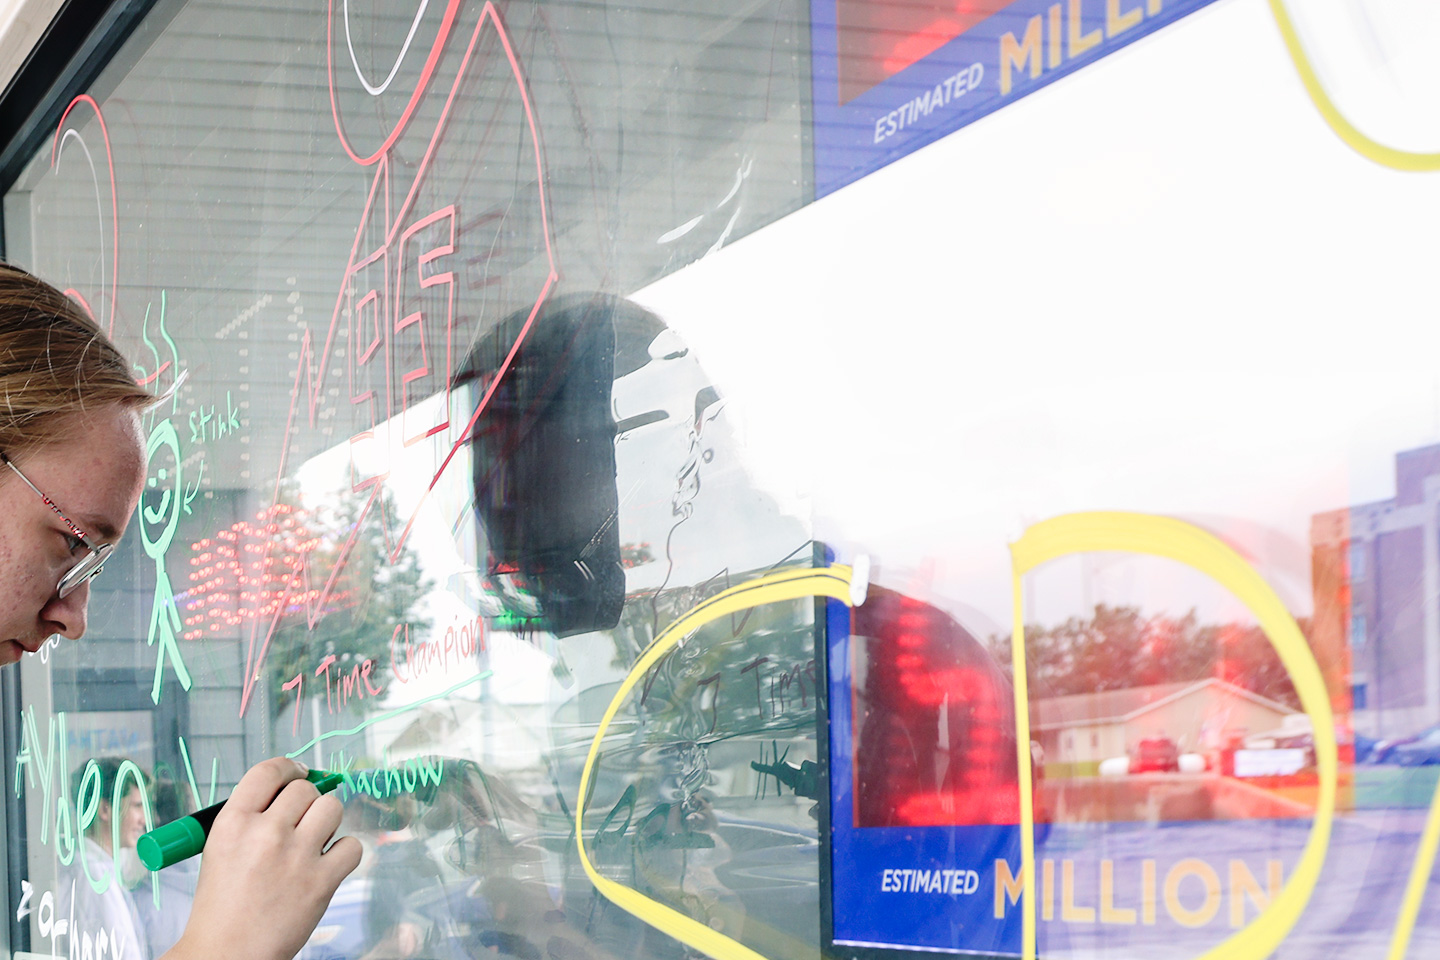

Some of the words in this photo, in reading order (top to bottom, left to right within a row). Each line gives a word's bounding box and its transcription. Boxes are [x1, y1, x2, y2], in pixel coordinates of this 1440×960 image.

[873, 61, 984, 144] ESTIMATED
[999, 0, 1162, 97] MILL
[282, 672, 302, 737] 7
[315, 653, 382, 714] Time
[391, 614, 486, 684] Champion
[881, 868, 979, 895] ESTIMATED
[994, 858, 1283, 929] MILLION
